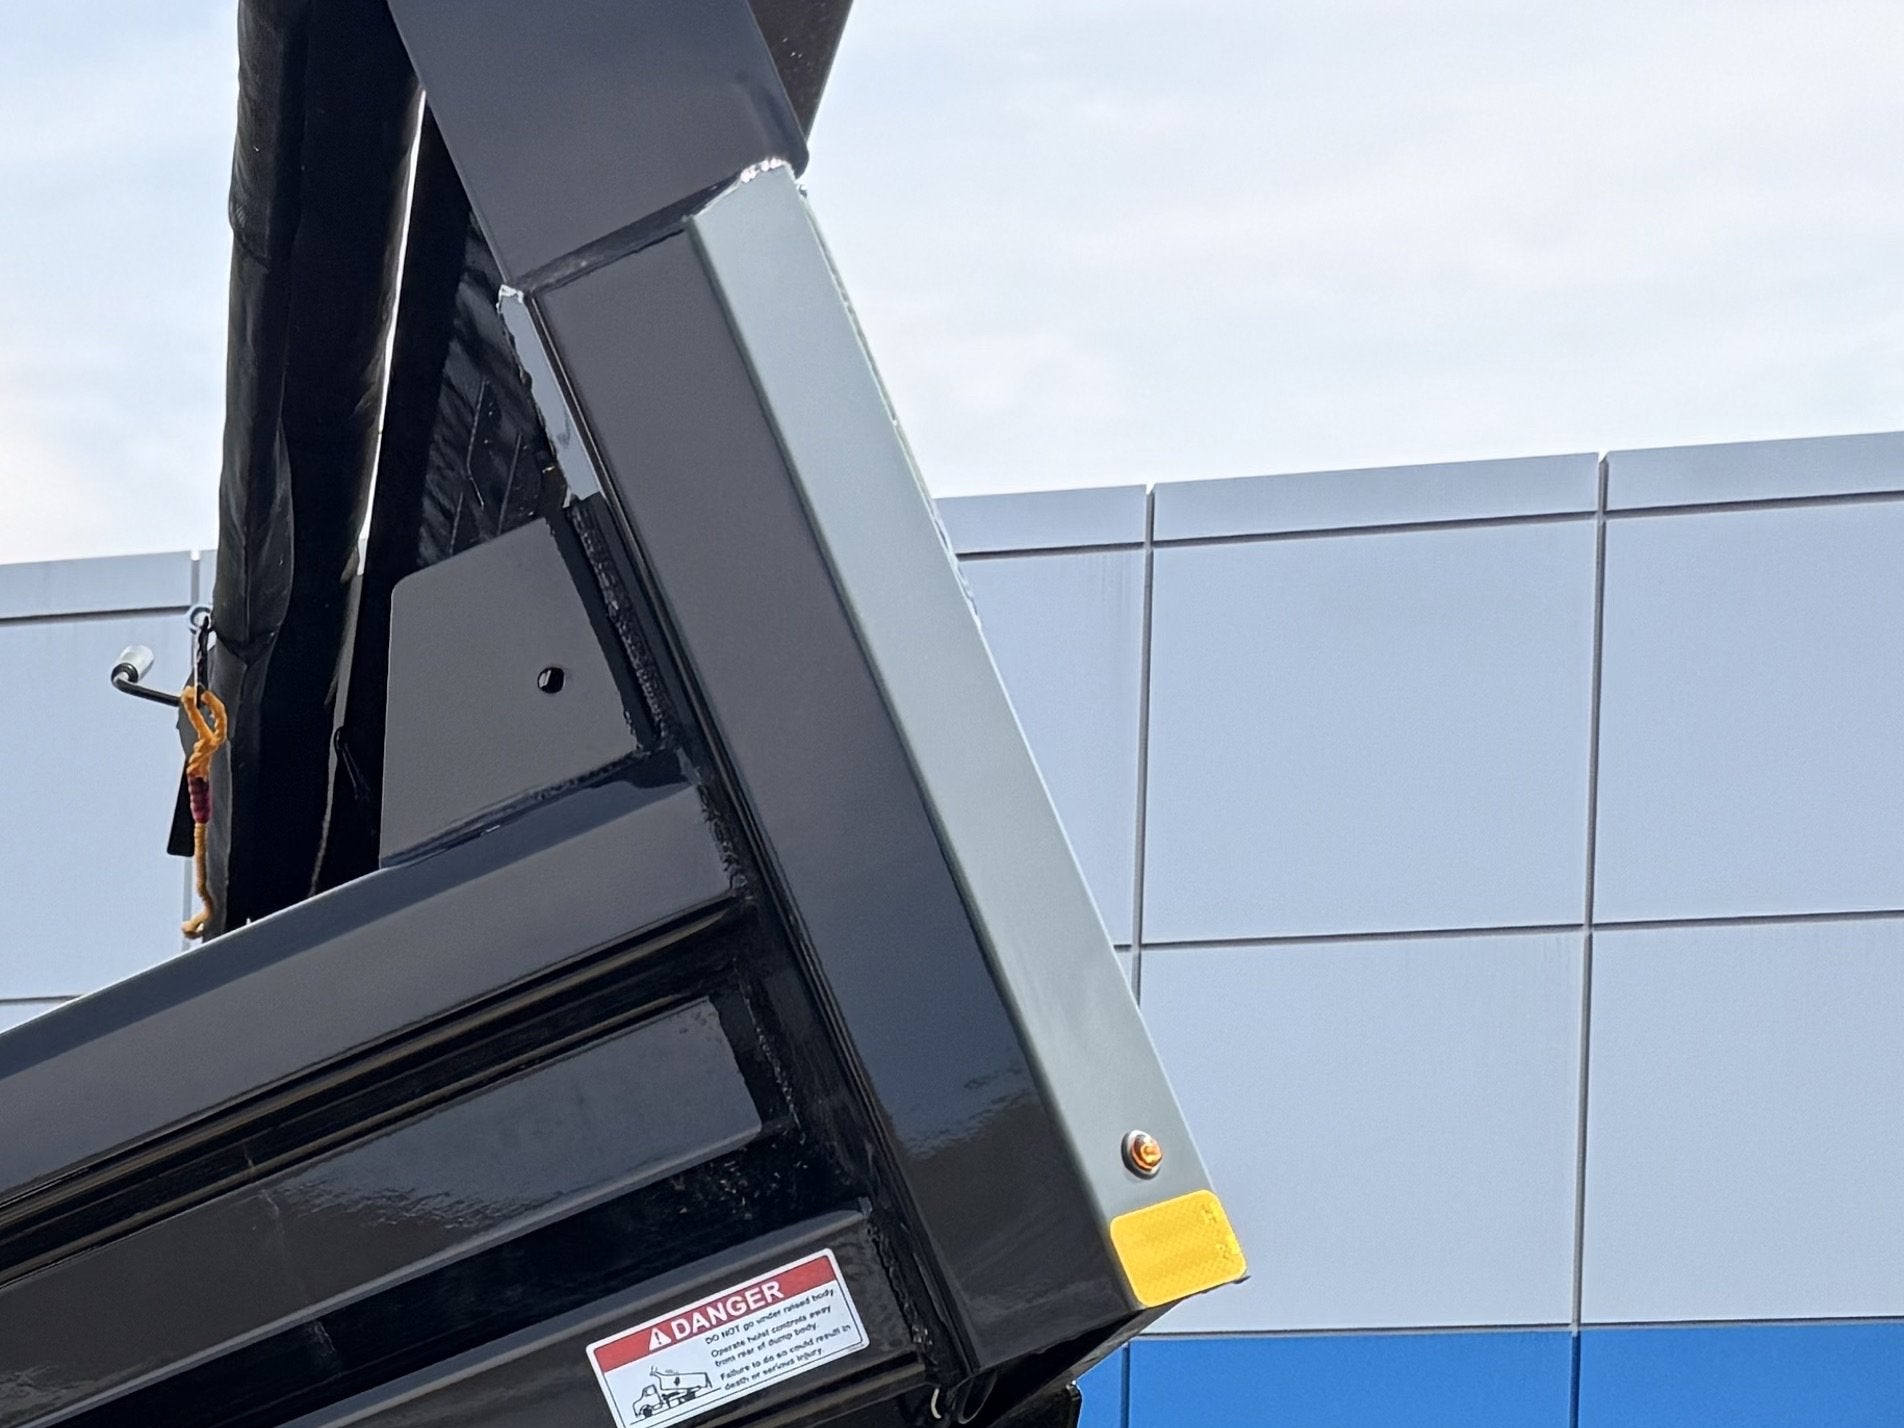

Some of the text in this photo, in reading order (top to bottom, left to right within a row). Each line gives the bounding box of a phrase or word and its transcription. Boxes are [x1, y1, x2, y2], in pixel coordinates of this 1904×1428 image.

[670, 1280, 784, 1339] DANGER
[721, 1325, 741, 1337] NOT
[742, 1320, 754, 1330] go
